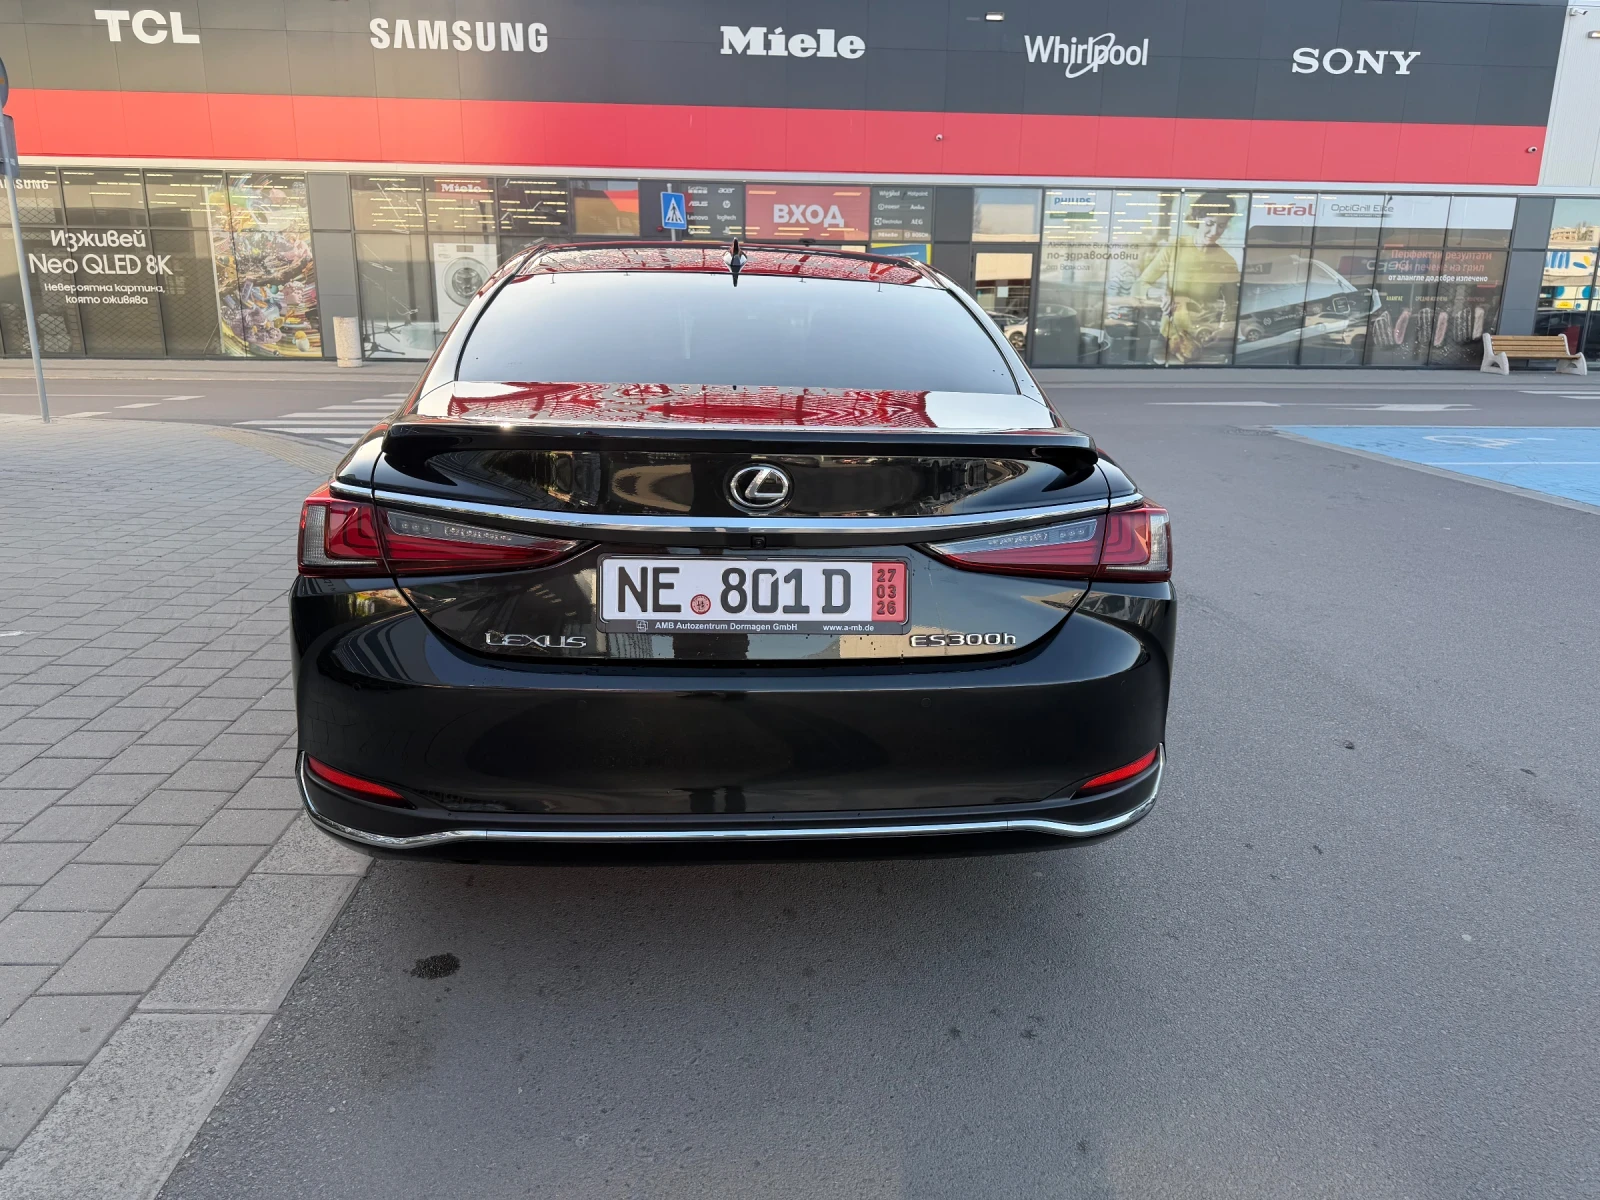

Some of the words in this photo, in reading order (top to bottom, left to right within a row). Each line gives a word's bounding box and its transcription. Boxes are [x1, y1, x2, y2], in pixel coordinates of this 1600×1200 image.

[94, 9, 200, 44] TCL
[369, 17, 548, 53] SAMSUNG
[720, 25, 866, 59] Miele
[1024, 32, 1149, 78] Whirlpool
[1291, 47, 1421, 74] SONY
[773, 204, 845, 228] ВХОД
[1264, 202, 1316, 217] Tefal
[1330, 203, 1371, 213] OptiGrill
[50, 229, 147, 252] Изживей
[28, 253, 79, 274] Neo
[82, 253, 142, 275] QLED
[145, 254, 174, 275] 8K
[1046, 250, 1139, 262] по-здравословни
[44, 283, 113, 294] Невероятна
[114, 283, 166, 295] картина,
[65, 295, 101, 304] която
[102, 295, 149, 305] оживява
[876, 568, 897, 583] 27
[617, 566, 682, 613] NE
[720, 566, 810, 614] 801
[821, 568, 851, 614] D
[876, 584, 897, 599] 03
[876, 600, 897, 615] 26
[654, 621, 675, 630] AMB
[676, 621, 728, 631] Autozentrum
[729, 622, 771, 632] Dormagen
[773, 623, 798, 631] GmbH
[823, 624, 875, 632] www.a-mb.de
[485, 631, 588, 649] LEXUS
[909, 632, 1017, 648] ES300h
